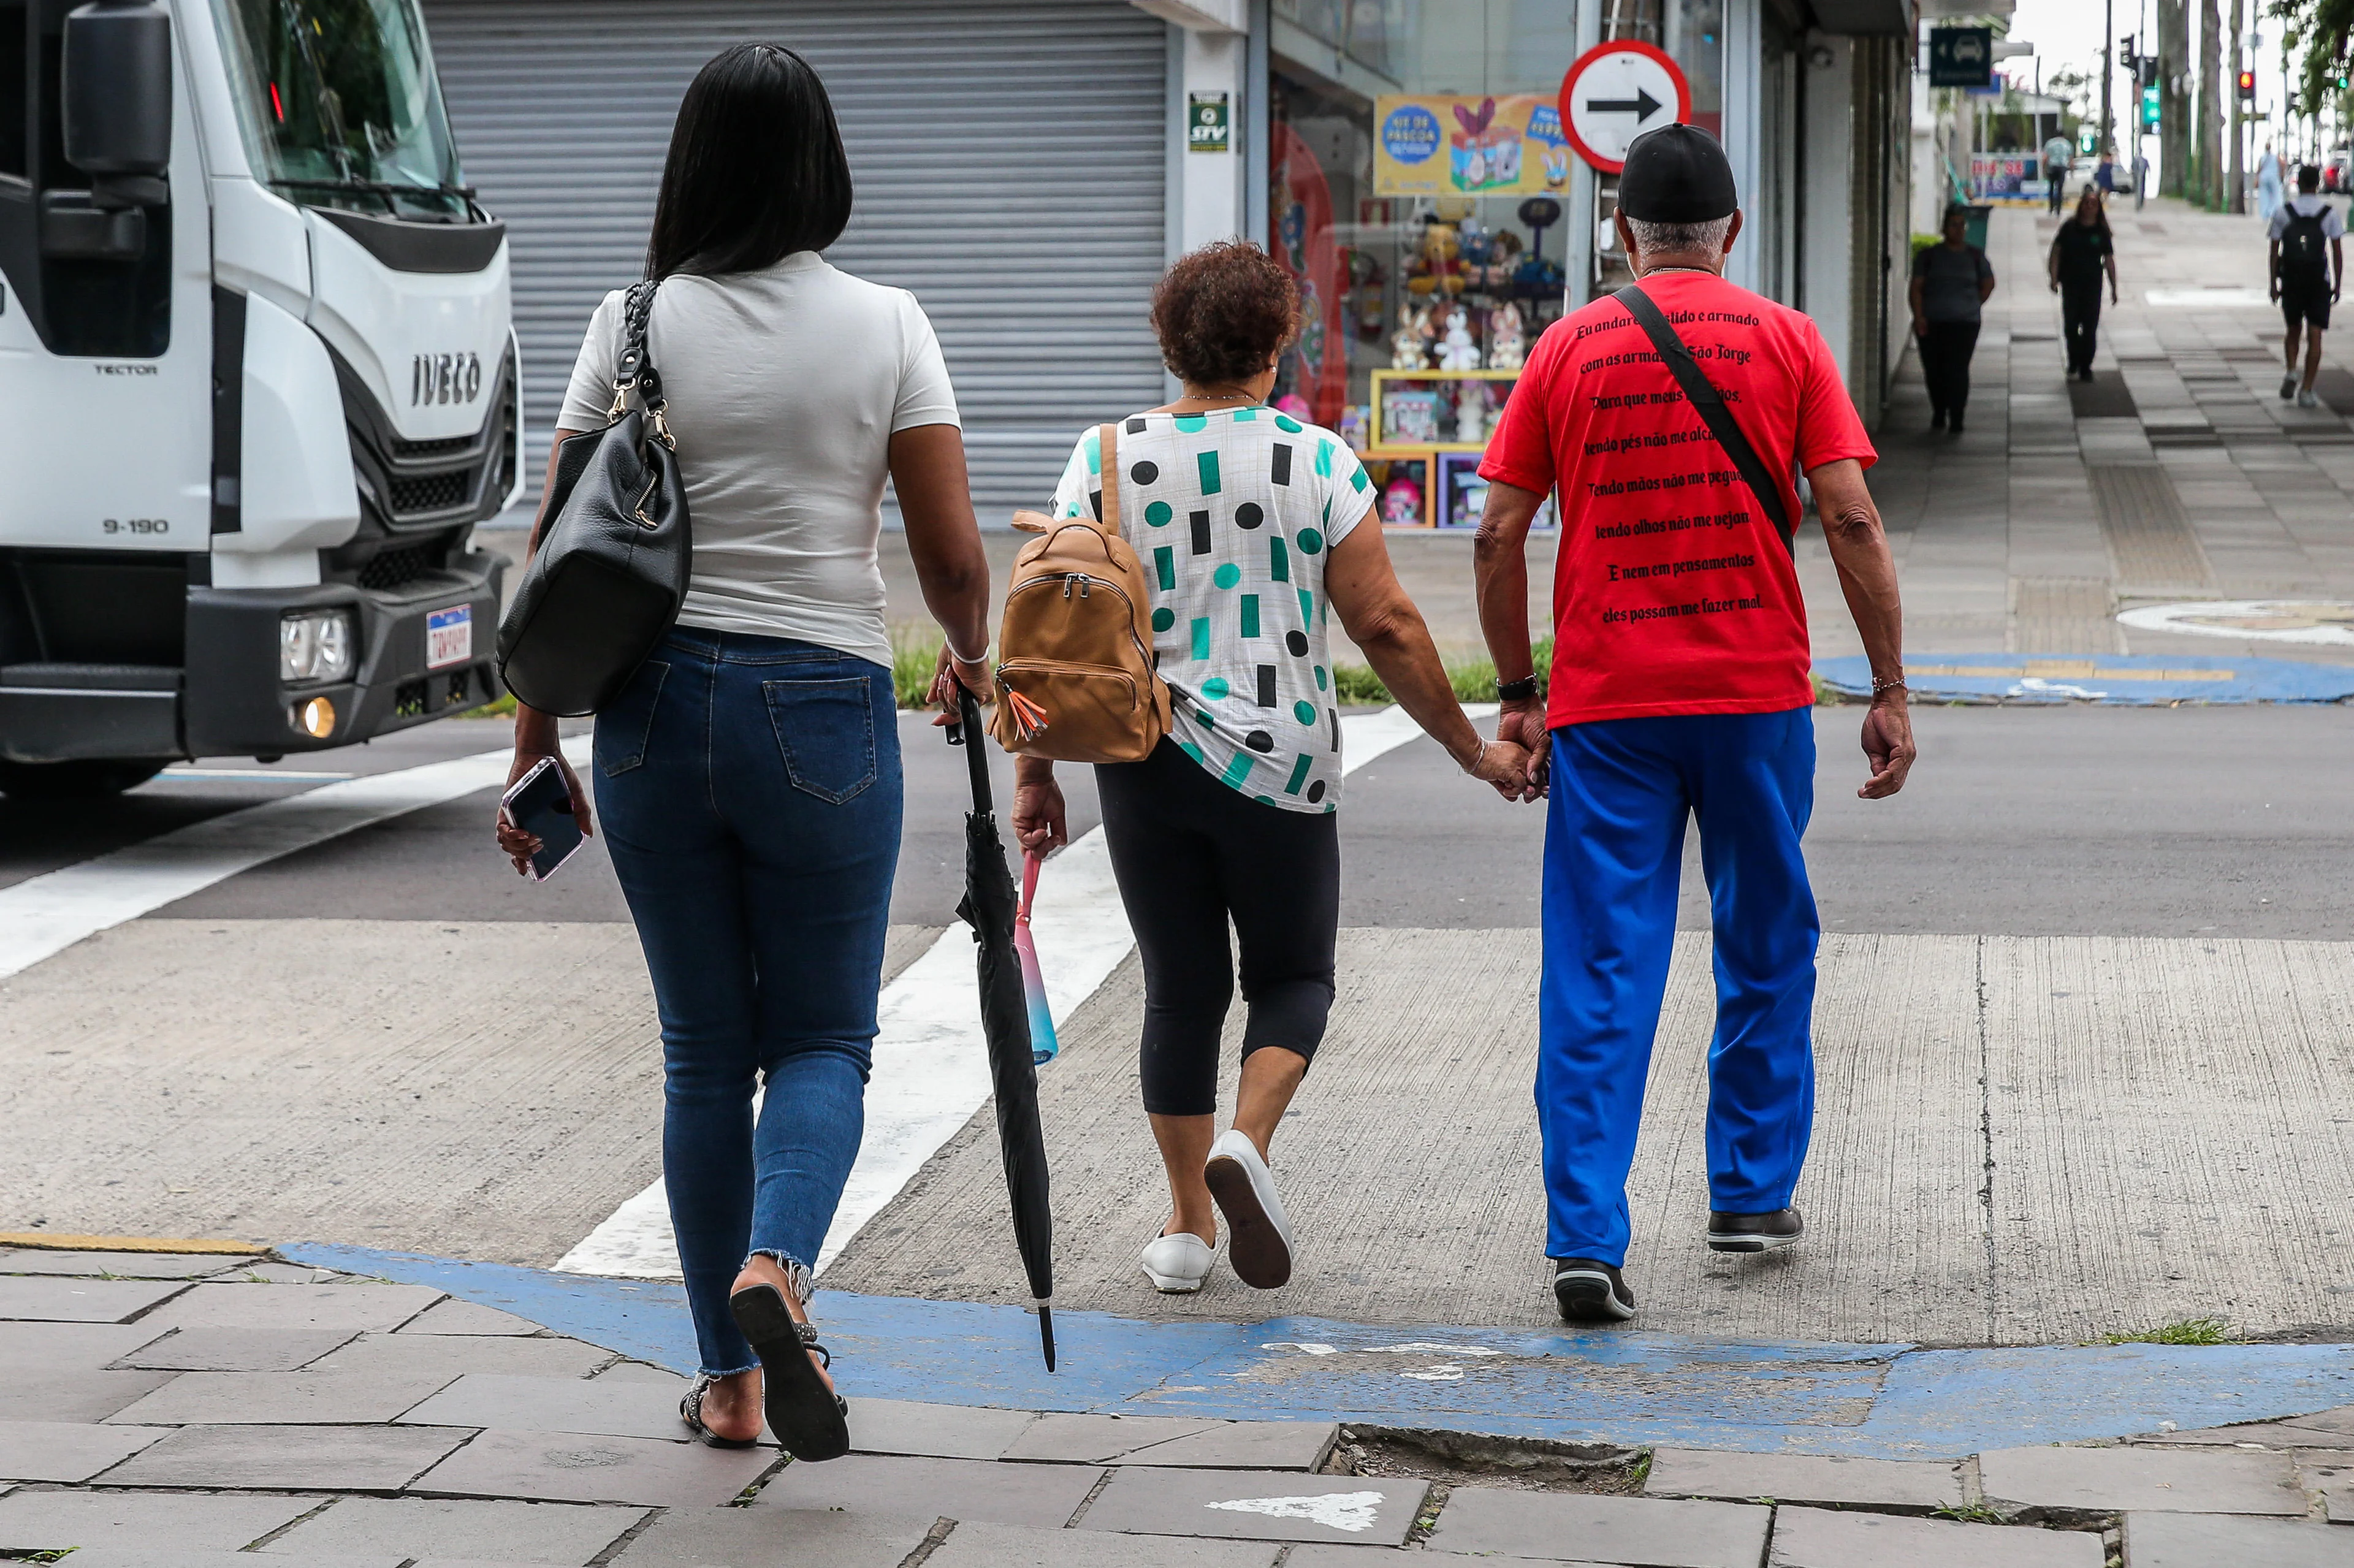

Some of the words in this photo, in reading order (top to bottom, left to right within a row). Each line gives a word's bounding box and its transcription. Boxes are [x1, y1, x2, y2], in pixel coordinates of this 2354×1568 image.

[1190, 125, 1227, 141] STV
[1576, 325, 1592, 340] Eu
[1594, 316, 1640, 333] andare
[1698, 311, 1704, 321] e
[1708, 311, 1759, 326] armado
[94, 364, 157, 375] TECTOR
[1580, 358, 1604, 374] com
[1607, 353, 1620, 367] as
[1686, 345, 1712, 359] São
[1715, 343, 1751, 365] Jorge
[411, 352, 479, 406] IVECO
[1589, 396, 1622, 410] Para
[1624, 393, 1647, 410] que
[1650, 390, 1683, 403] meus
[1621, 433, 1641, 454] pés
[1644, 432, 1667, 447] não
[1670, 431, 1688, 444] me
[1587, 479, 1624, 497] Tendo
[1626, 477, 1660, 492] mãos
[1663, 474, 1685, 489] não
[1687, 472, 1706, 485] me
[102, 519, 169, 534] 9-190
[1633, 519, 1666, 535] olhos
[1669, 516, 1691, 531] não
[1693, 515, 1712, 528] me
[1606, 564, 1619, 582] E
[1622, 565, 1650, 580] nem
[1651, 564, 1670, 577] em
[1673, 553, 1755, 578] pensamentos
[1602, 607, 1628, 623] eles
[1629, 606, 1679, 625] possam
[1681, 603, 1700, 615] me
[1702, 597, 1735, 613] fazer
